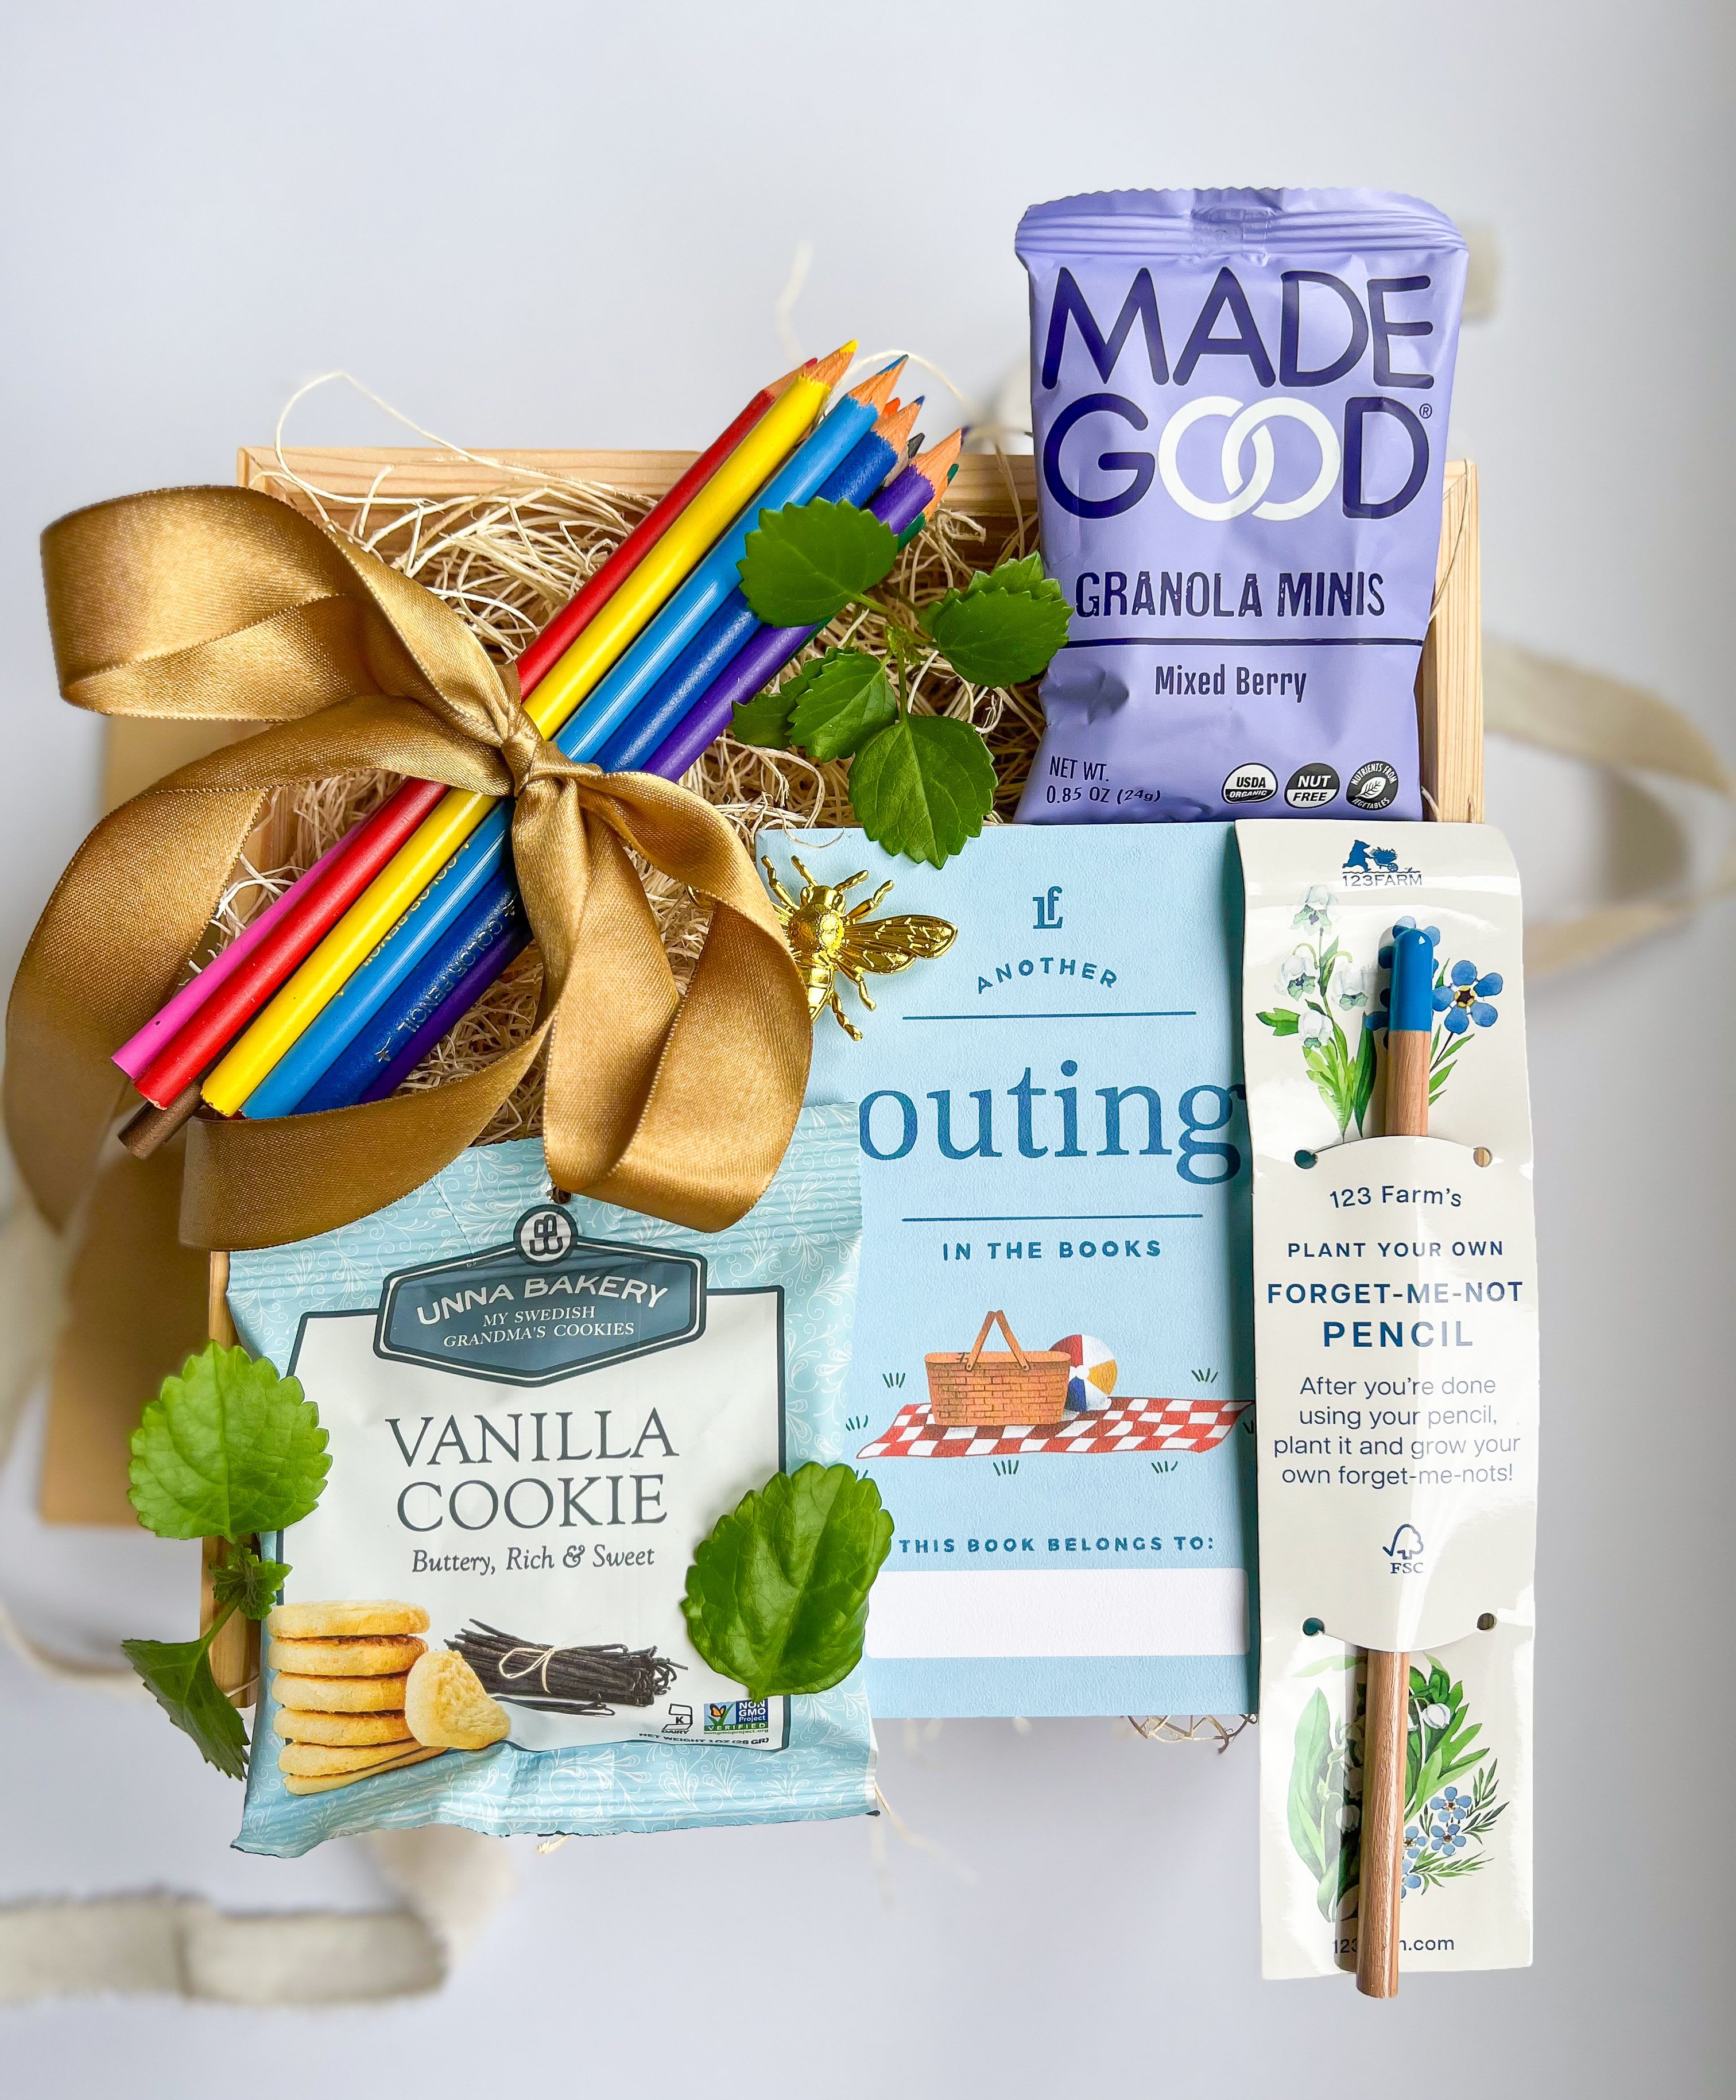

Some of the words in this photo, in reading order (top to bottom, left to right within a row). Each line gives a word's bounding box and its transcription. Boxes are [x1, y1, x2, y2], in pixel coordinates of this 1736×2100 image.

[1041, 266, 1433, 389] MADE
[1075, 572, 1263, 618] GRANOLA
[1277, 572, 1385, 618] MINIS
[1154, 665, 1226, 696] Mixed
[1236, 667, 1307, 703] Berry
[1049, 756, 1077, 778] NET
[1083, 762, 1109, 782] WT.
[1351, 763, 1382, 786] NUTRIENTS
[1381, 765, 1397, 784] FROM
[1236, 776, 1266, 788] USDA
[1297, 775, 1331, 788] NUT
[1046, 785, 1083, 803] 0.85
[1089, 786, 1110, 803] OZ
[1116, 788, 1161, 805] (24g)
[1229, 789, 1268, 799] ORGANIC
[1292, 792, 1327, 801] FREE
[1342, 874, 1423, 887] 123FARM
[978, 956, 1118, 994] ANOTHER
[859, 1060, 1246, 1185] outing
[1330, 1187, 1372, 1208] 123
[1382, 1185, 1462, 1207] Farm's
[943, 1243, 971, 1260] IN
[988, 1242, 1043, 1258] THE
[1060, 1240, 1161, 1258] BOOKS
[1288, 1242, 1366, 1258] PLANT
[1377, 1242, 1442, 1257] YOUR
[1452, 1241, 1503, 1257] OWN
[417, 1284, 514, 1325] UNNA
[524, 1275, 669, 1308] BAKERY
[1267, 1281, 1523, 1304] FORGET-ME-NOT
[483, 1312, 509, 1327] MY
[514, 1306, 595, 1323] SWEDISH
[444, 1327, 546, 1347] GRANDMA'S
[554, 1323, 634, 1336] COOKIES
[1323, 1321, 1473, 1347] PENCIL
[1300, 1377, 1357, 1396] After
[1364, 1378, 1434, 1400] you're
[1442, 1377, 1496, 1395] done
[1299, 1407, 1361, 1429] using
[1369, 1410, 1420, 1429] your
[1428, 1405, 1497, 1429] pencil,
[385, 1407, 679, 1467] VANILLA
[1274, 1436, 1331, 1458] plant
[1338, 1436, 1353, 1455] it
[1360, 1436, 1403, 1455] and
[1411, 1441, 1466, 1459] grow
[1474, 1437, 1521, 1457] your
[1282, 1469, 1330, 1485] own
[1338, 1463, 1513, 1489] forget-me-nots!
[397, 1474, 668, 1532] COOKIE
[899, 1539, 955, 1553] THIS
[968, 1539, 1035, 1552] BOOK
[1048, 1537, 1162, 1551] BELONGS
[1174, 1536, 1214, 1551] TO:
[412, 1549, 497, 1575] Buttery,
[506, 1547, 555, 1570] Rich
[563, 1545, 586, 1568] &
[593, 1544, 654, 1567] Sweet
[1390, 1563, 1424, 1574] FSC
[739, 1700, 765, 1709] NON
[739, 1708, 766, 1716] GMO
[1333, 1938, 1455, 1954] 123.com
